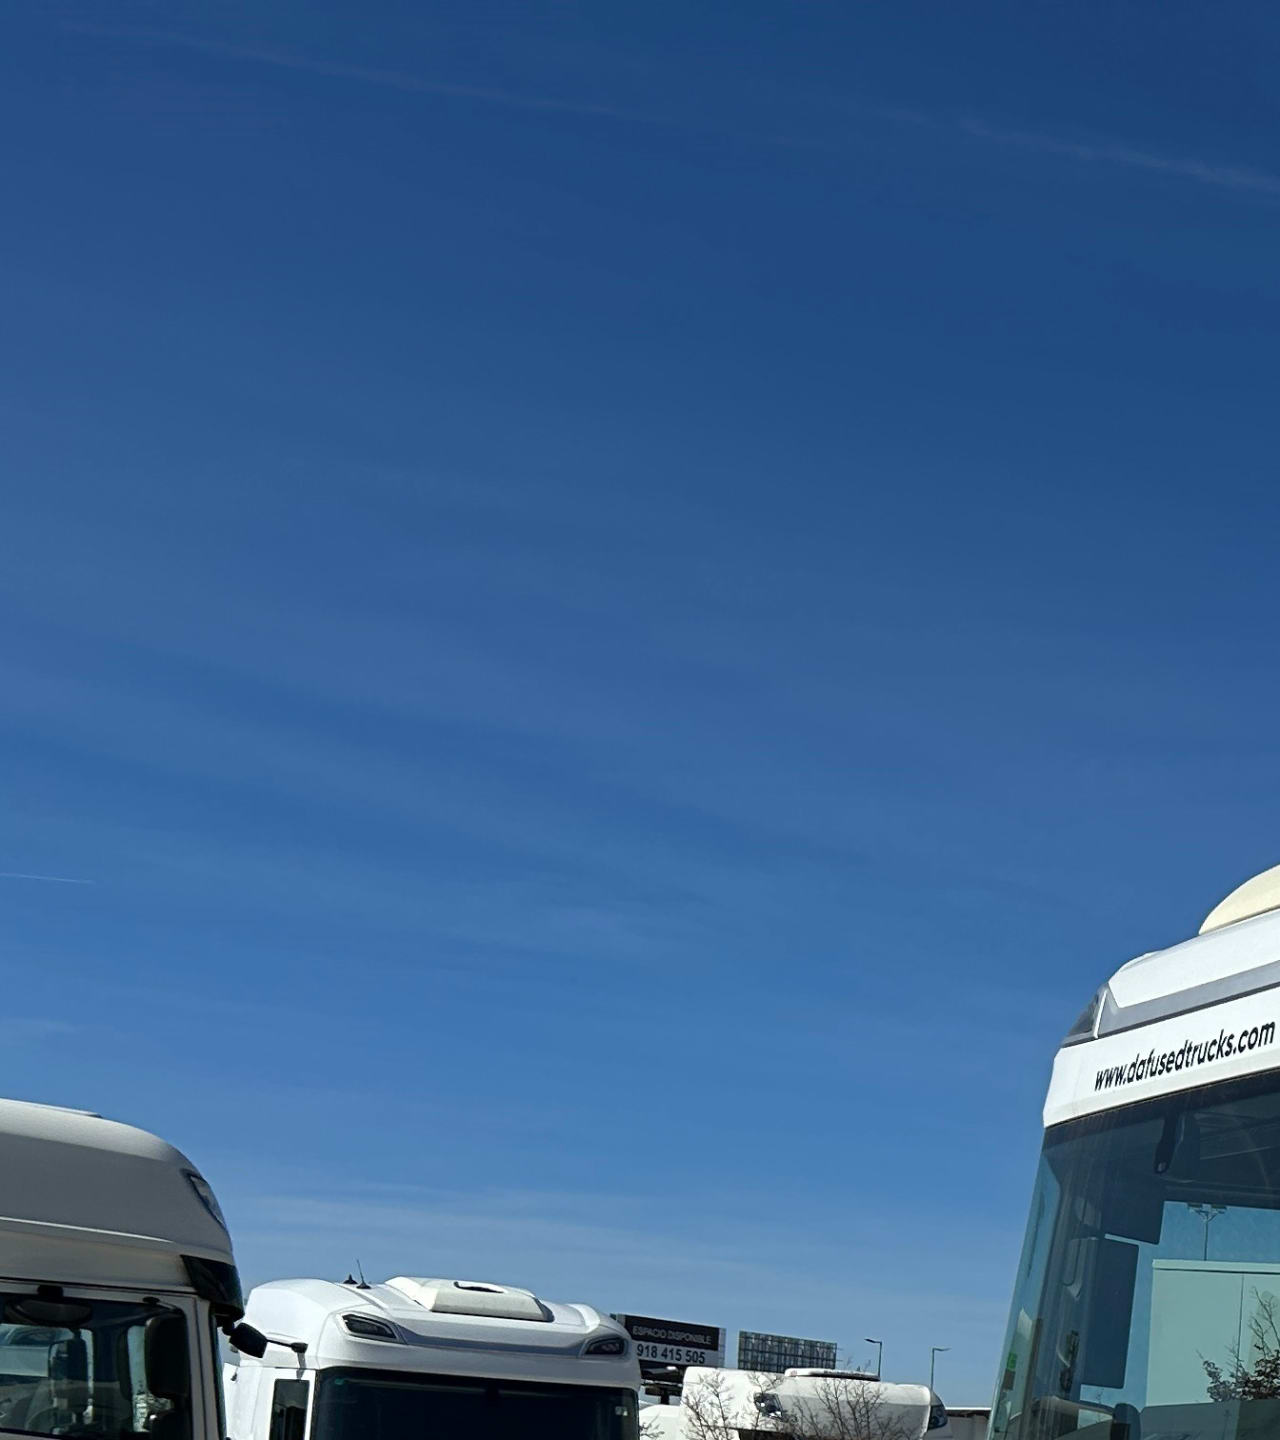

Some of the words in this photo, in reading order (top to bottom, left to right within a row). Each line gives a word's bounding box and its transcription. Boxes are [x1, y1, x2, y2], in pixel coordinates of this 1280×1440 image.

[1094, 1021, 1276, 1091] www.dafusedtrucks.com
[633, 1325, 667, 1339] ESPACIO
[667, 1329, 712, 1345] DISPONIBLE
[637, 1343, 658, 1358] 918
[661, 1345, 682, 1361] 415
[685, 1350, 706, 1364] 505
